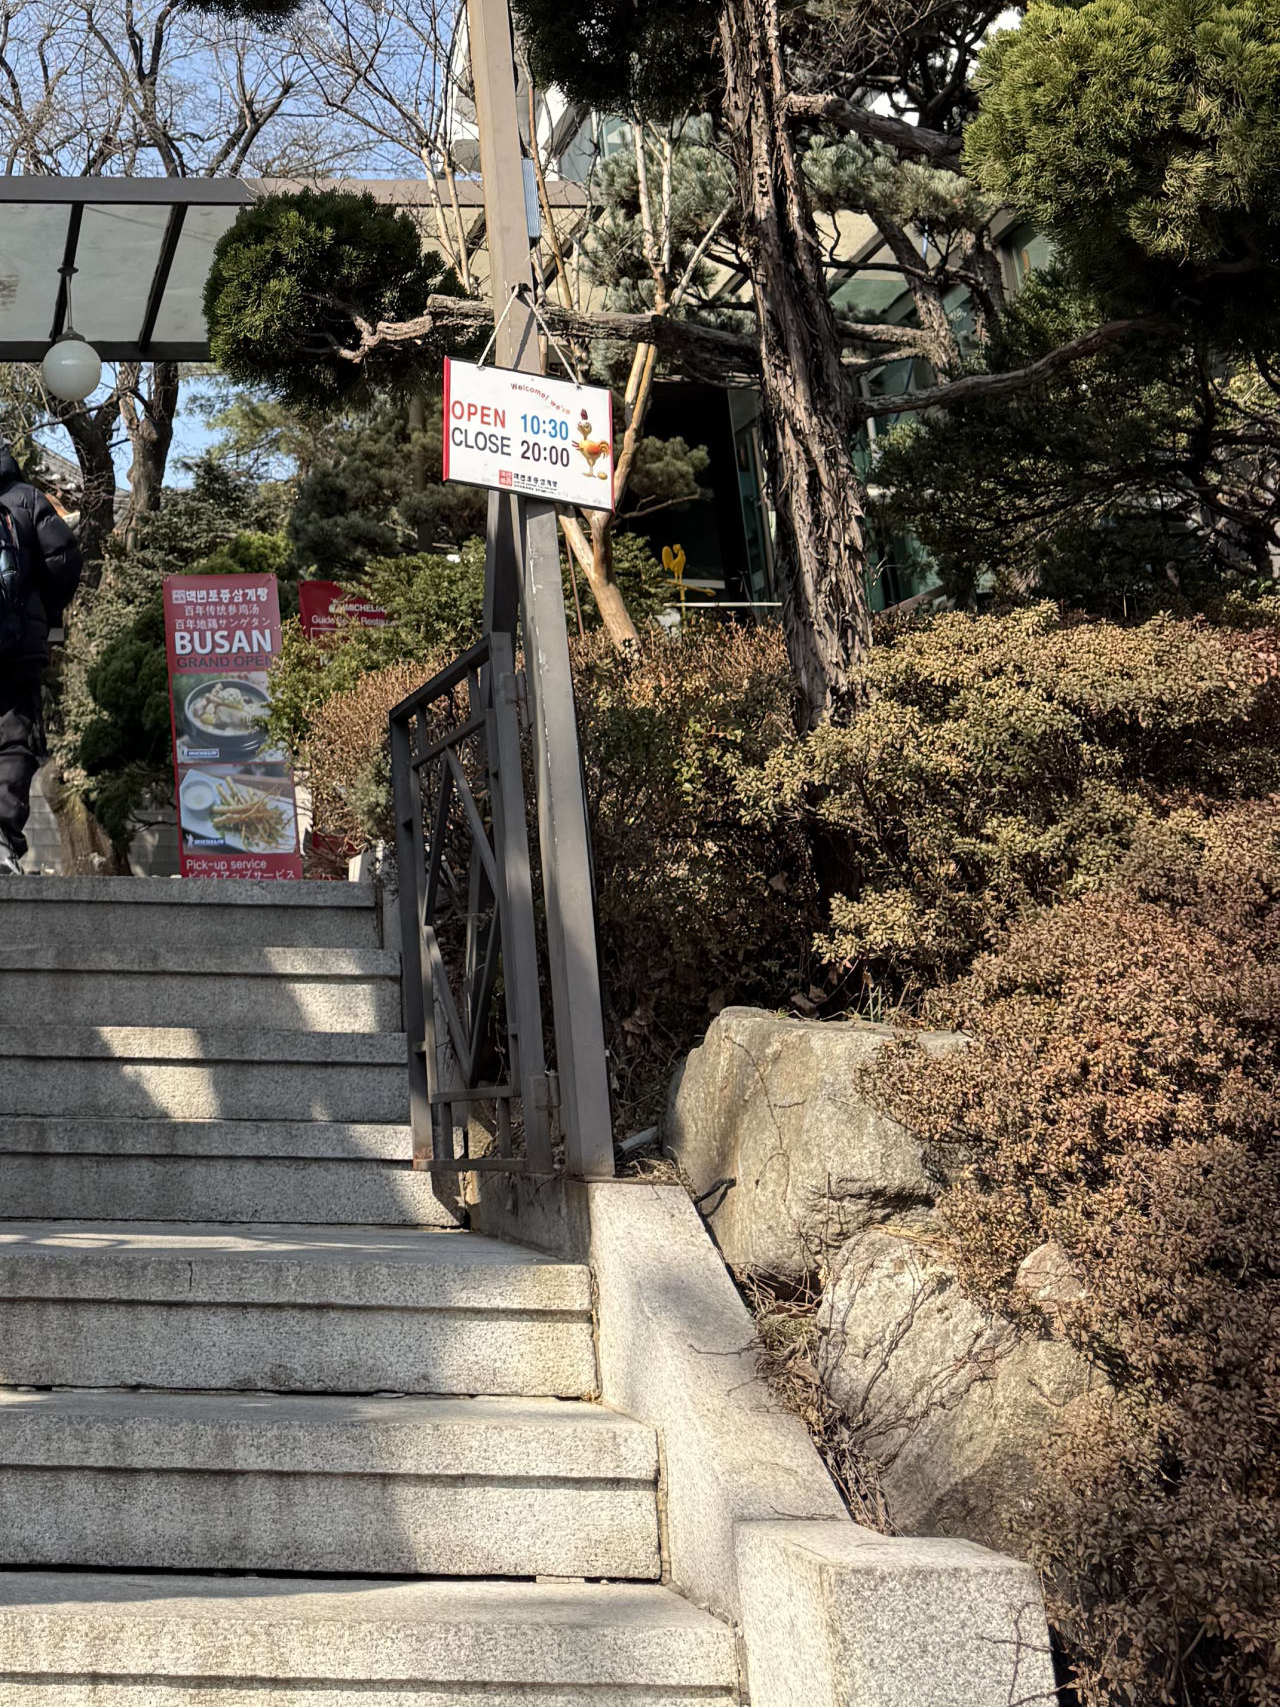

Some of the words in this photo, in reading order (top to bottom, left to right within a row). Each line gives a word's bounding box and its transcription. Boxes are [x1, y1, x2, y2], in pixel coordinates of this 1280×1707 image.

[451, 400, 506, 429] OPEN
[520, 413, 569, 441] 10:30
[451, 427, 512, 457] CLOSE
[521, 440, 570, 468] 20:00
[186, 587, 269, 603] 백년토종삼계탕
[174, 629, 273, 655] BUSAN
[176, 656, 231, 669] GRAND
[186, 858, 227, 871] Pick-up
[230, 859, 267, 870] service
